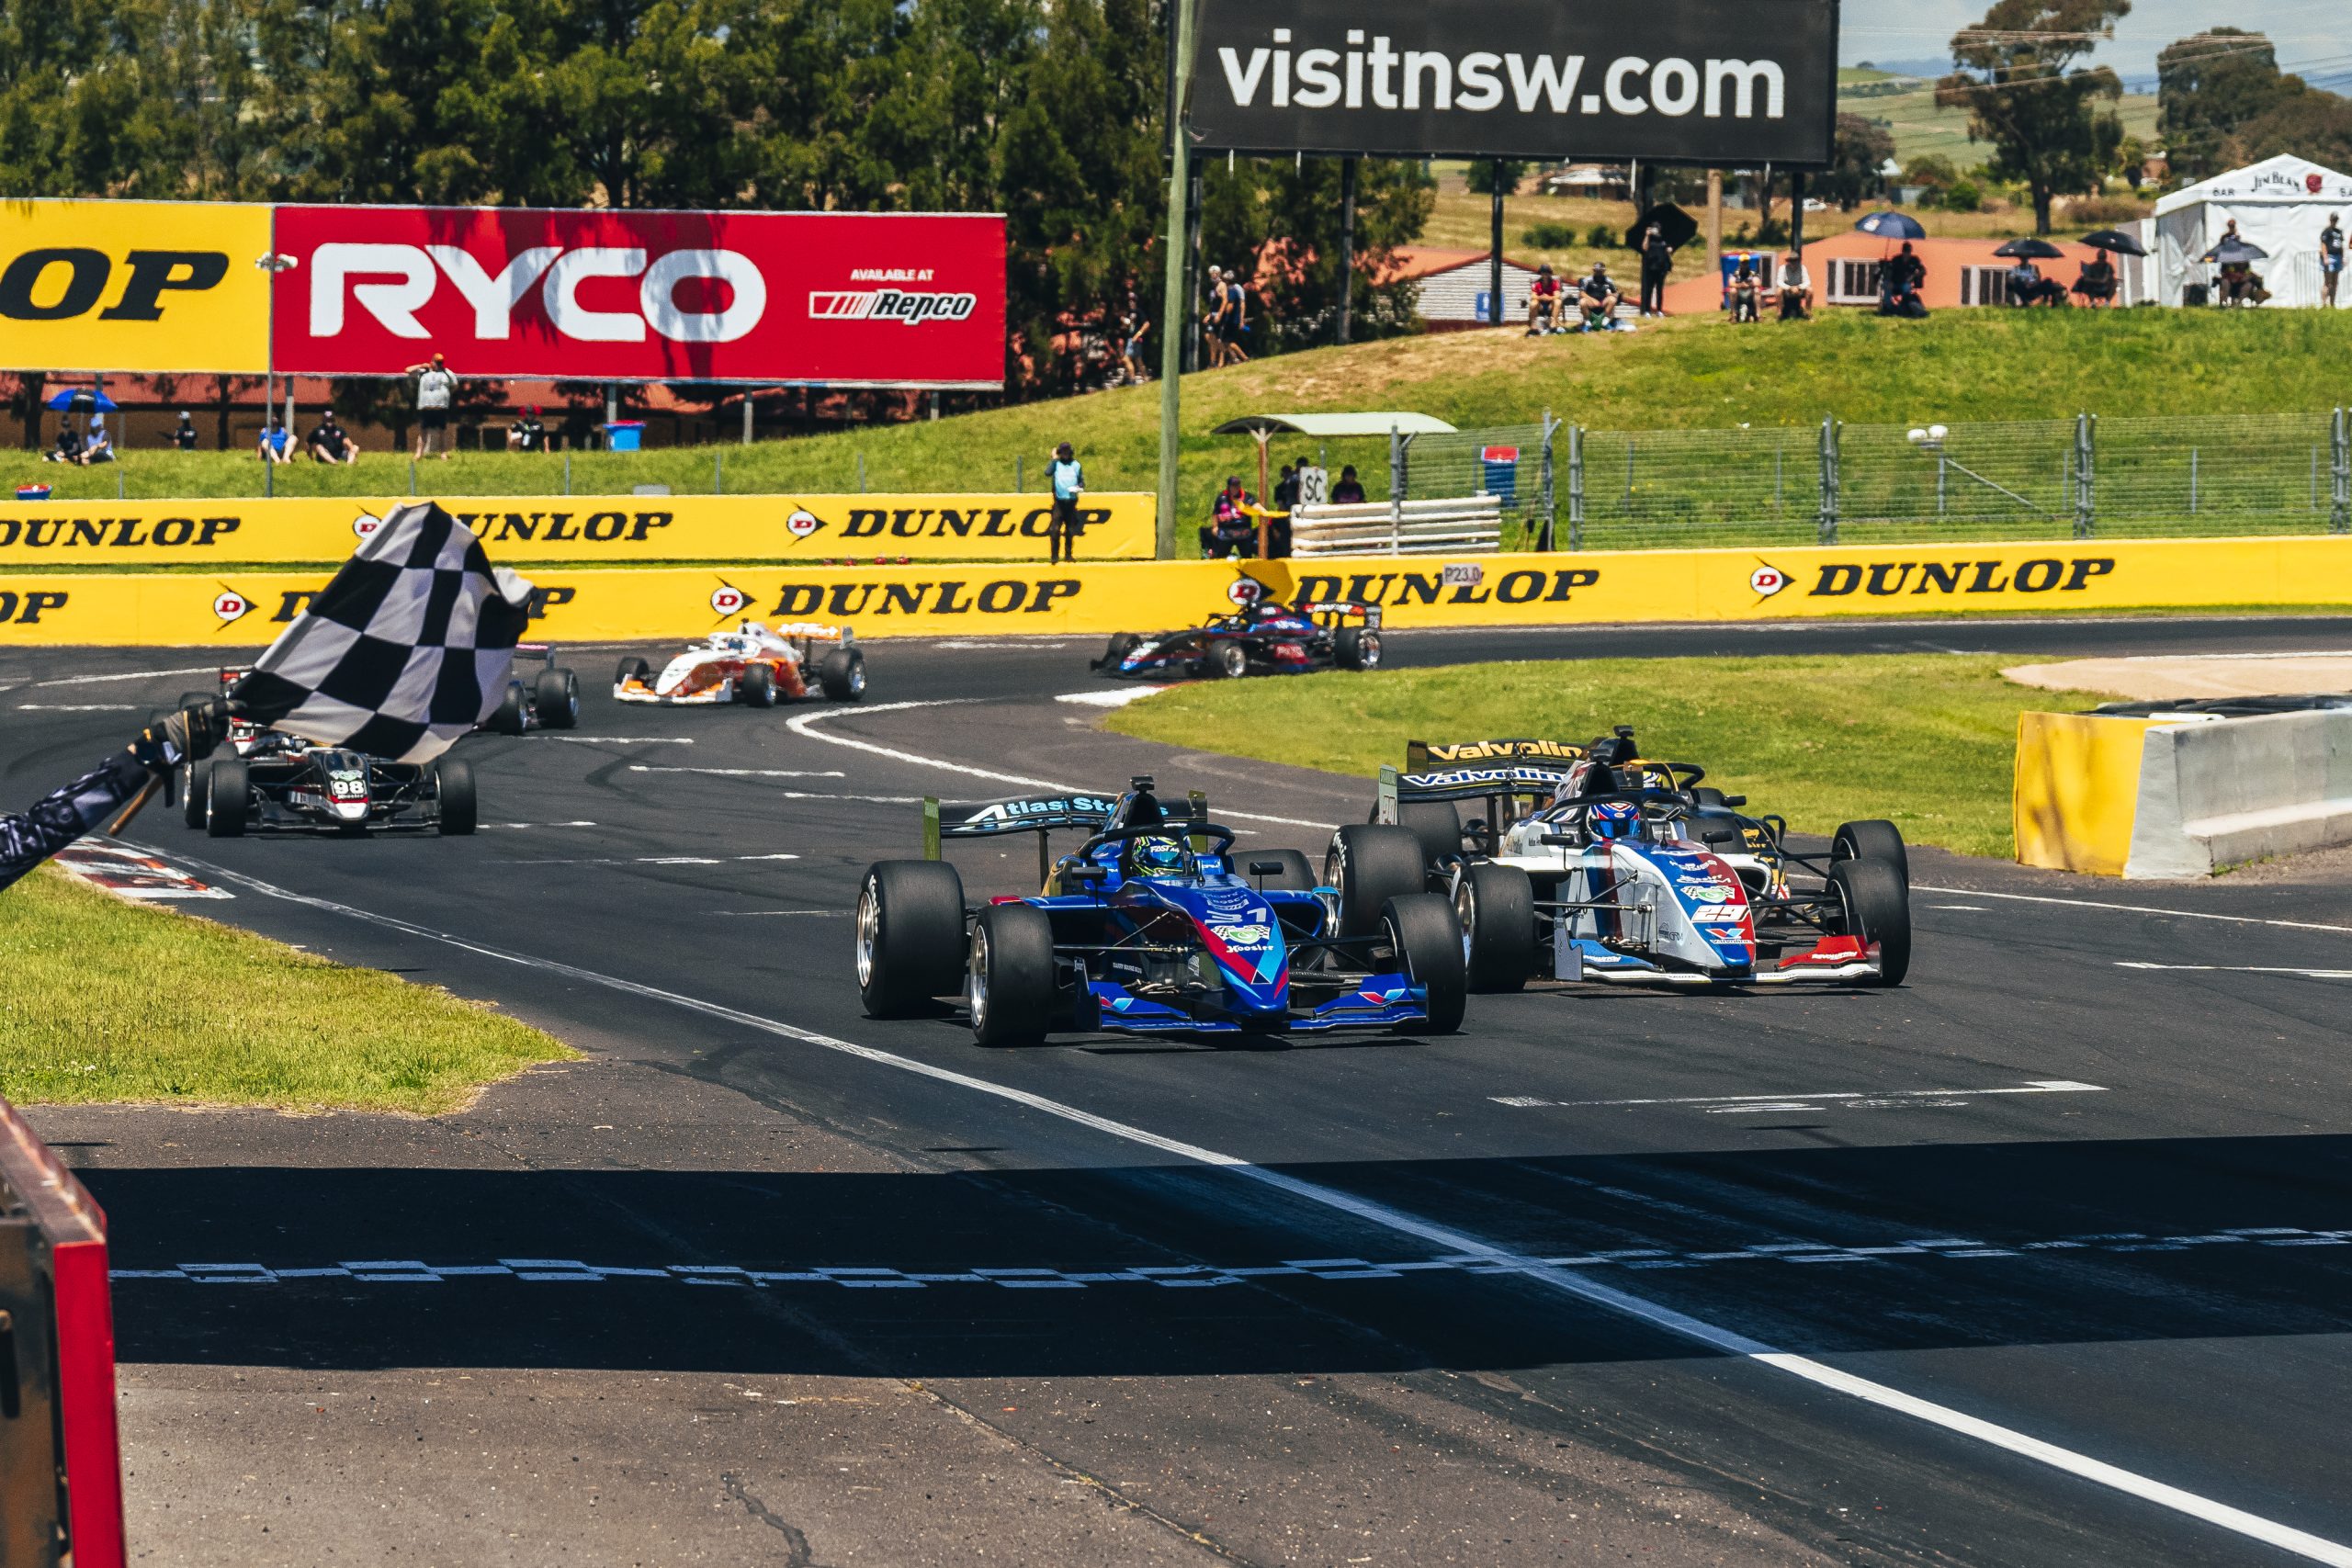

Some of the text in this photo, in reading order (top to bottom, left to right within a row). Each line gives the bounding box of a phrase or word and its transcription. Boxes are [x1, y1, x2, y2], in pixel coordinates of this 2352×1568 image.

[1218, 28, 1784, 118] visitnsw.com
[2212, 187, 2235, 197] BAR
[0, 248, 229, 321] OP
[851, 269, 935, 281] AVAILABLE AT
[310, 243, 766, 343] RYCO
[874, 290, 975, 322] Repco
[1305, 475, 1324, 502] SC
[458, 512, 673, 542] UNLOP
[839, 508, 1111, 537] DUNLOP
[1294, 570, 1599, 605] DUNLOP
[1808, 558, 2115, 596] DUNLOP
[769, 580, 1081, 616] DUNLOP
[1429, 740, 1582, 761] Valvolin
[333, 781, 365, 795] 98
[1402, 767, 1566, 787] Valvolin
[953, 797, 1070, 830] Atlas
[1204, 907, 1267, 925] 31
[1692, 905, 1749, 922] 29
